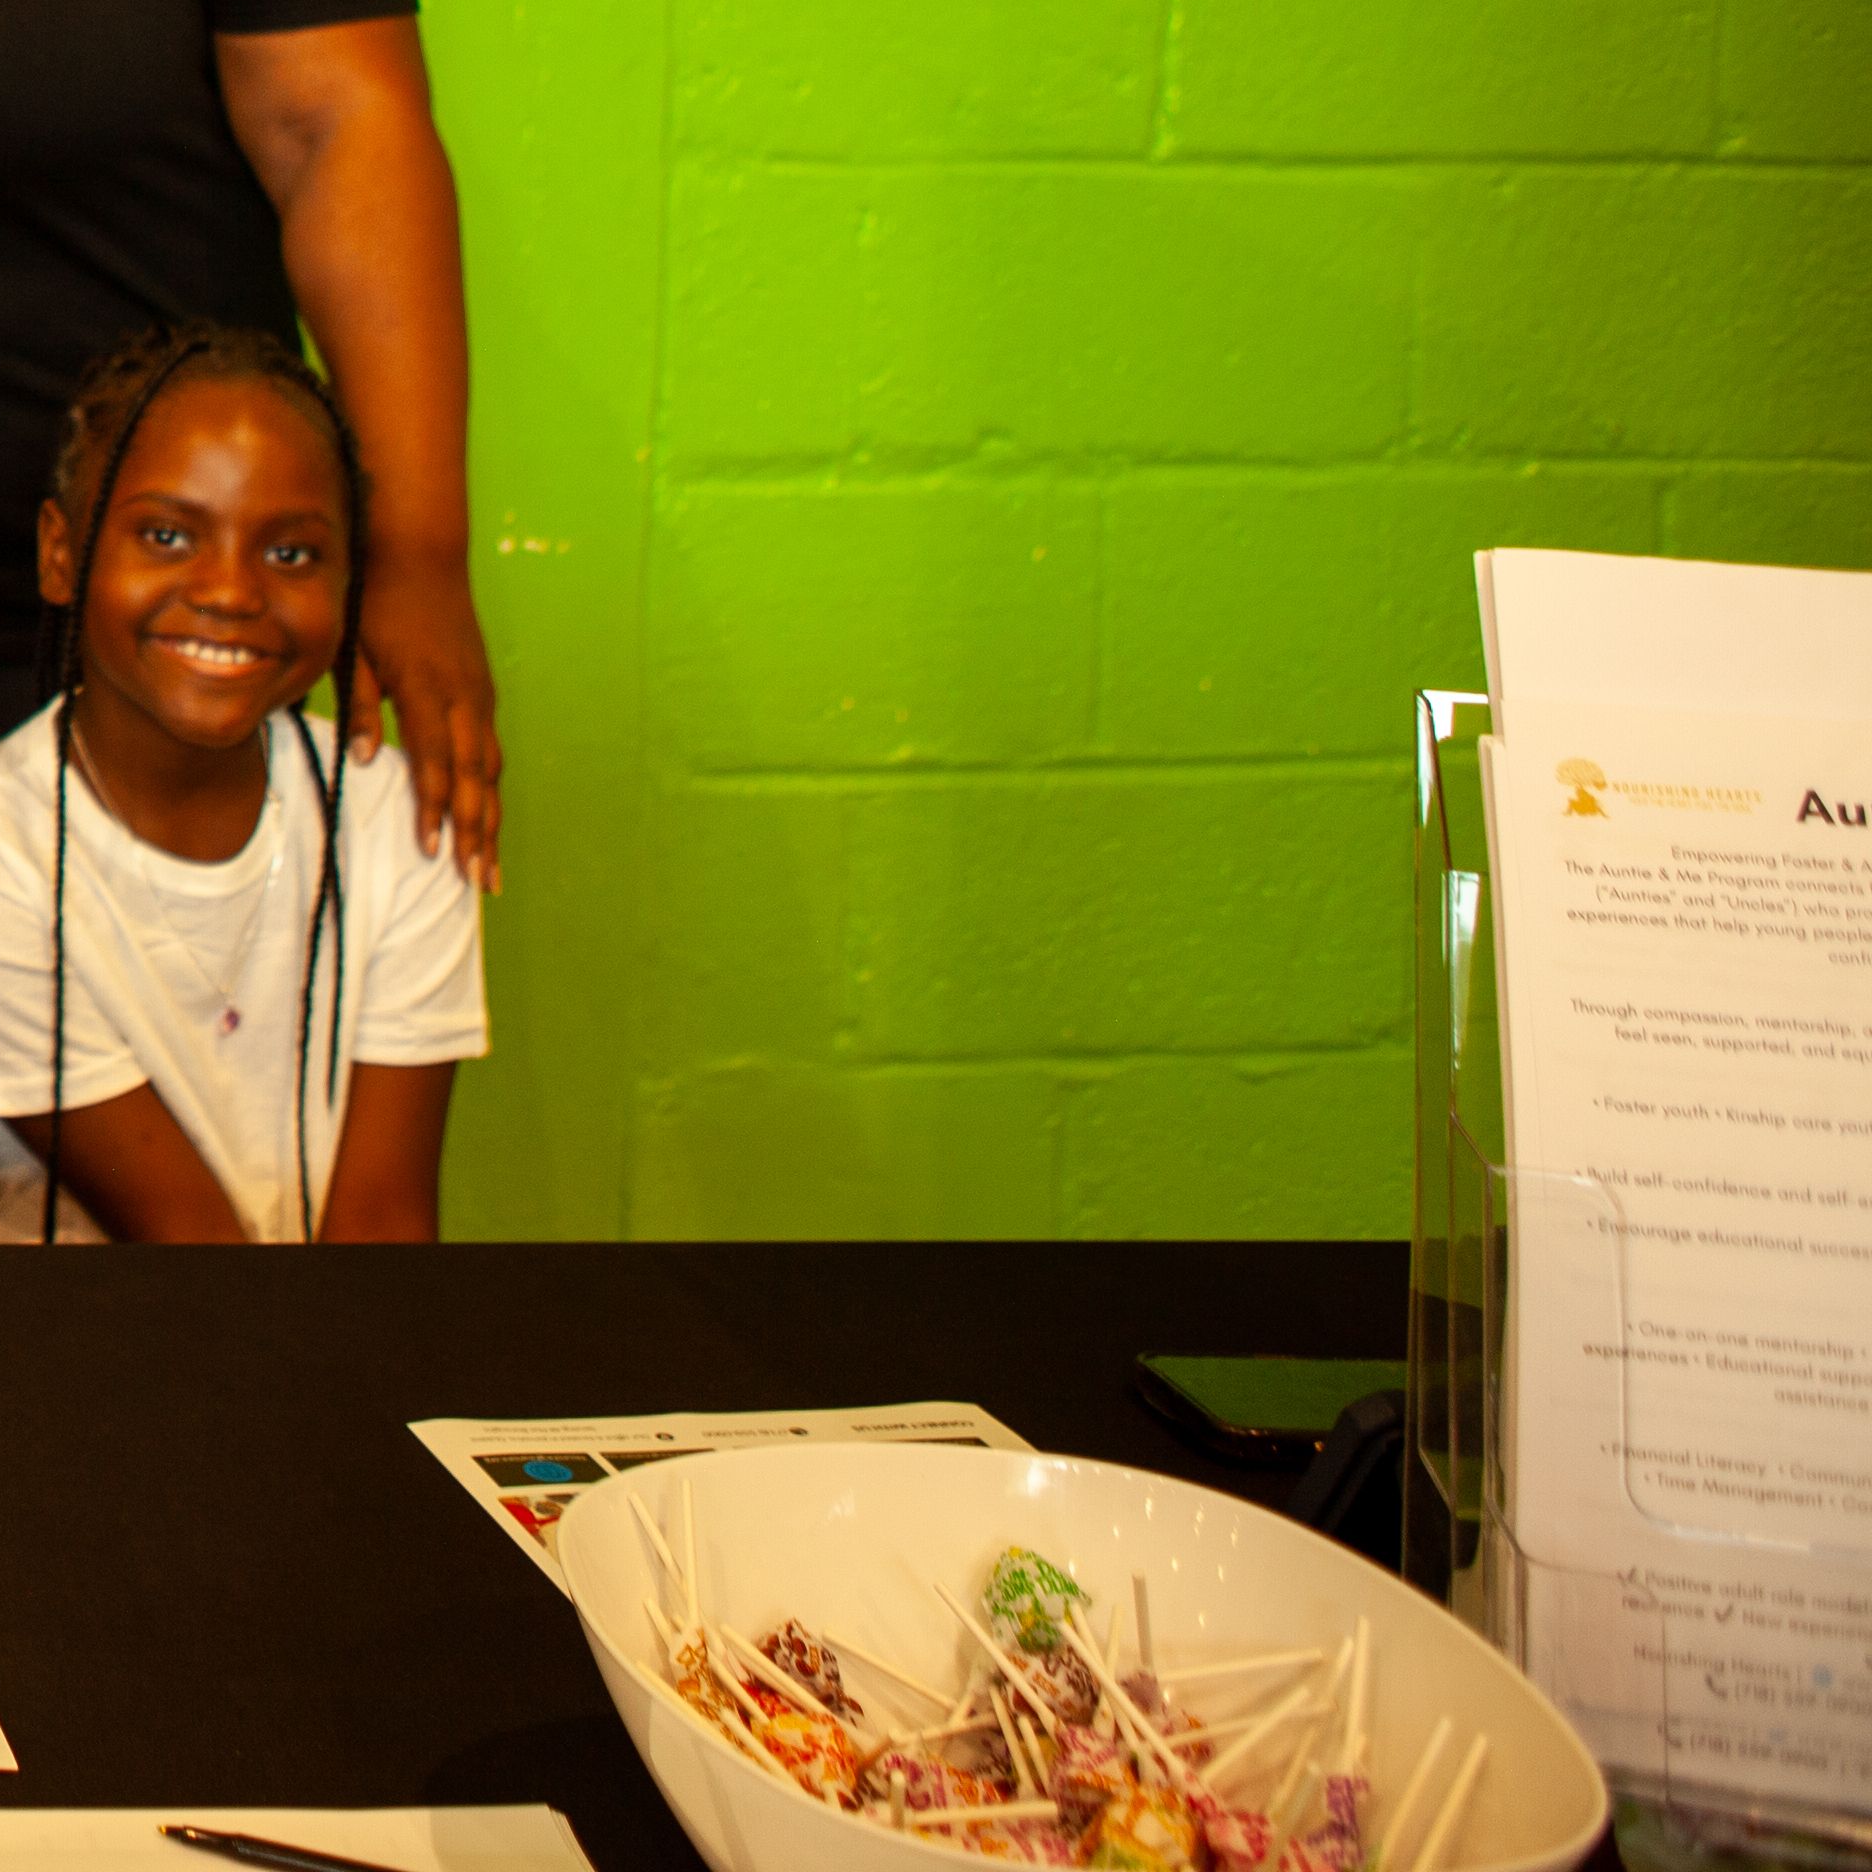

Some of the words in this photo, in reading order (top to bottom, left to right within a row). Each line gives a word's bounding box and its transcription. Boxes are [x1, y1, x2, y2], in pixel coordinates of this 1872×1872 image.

[1613, 783, 1699, 799] NOURISHING
[1707, 786, 1762, 803] HEARTS
[1796, 788, 1872, 827] Au
[1671, 845, 1777, 870] Empowering
[1781, 848, 1835, 871] Foster
[1564, 859, 1594, 876] The
[1600, 865, 1652, 881] Auntie
[1676, 870, 1702, 885] Me
[1708, 871, 1780, 895] Program
[1785, 880, 1863, 896] connects
[1683, 892, 1715, 909] and
[1804, 901, 1839, 918] who
[1566, 907, 1668, 929] experiences
[1674, 914, 1706, 930] that
[1712, 917, 1750, 936] help
[1755, 925, 1806, 942] young
[1570, 997, 1637, 1021] Through
[1643, 1009, 1749, 1029] compassion,
[1615, 1026, 1647, 1043] feel
[1801, 1043, 1835, 1059] and
[1604, 1095, 1657, 1116] Foster
[1662, 1101, 1709, 1122] youth
[1726, 1107, 1786, 1129] Kinship
[1792, 1118, 1832, 1133] care
[1777, 1186, 1813, 1205] and
[1597, 1218, 1692, 1244] Encourage
[1697, 1229, 1804, 1254] educational
